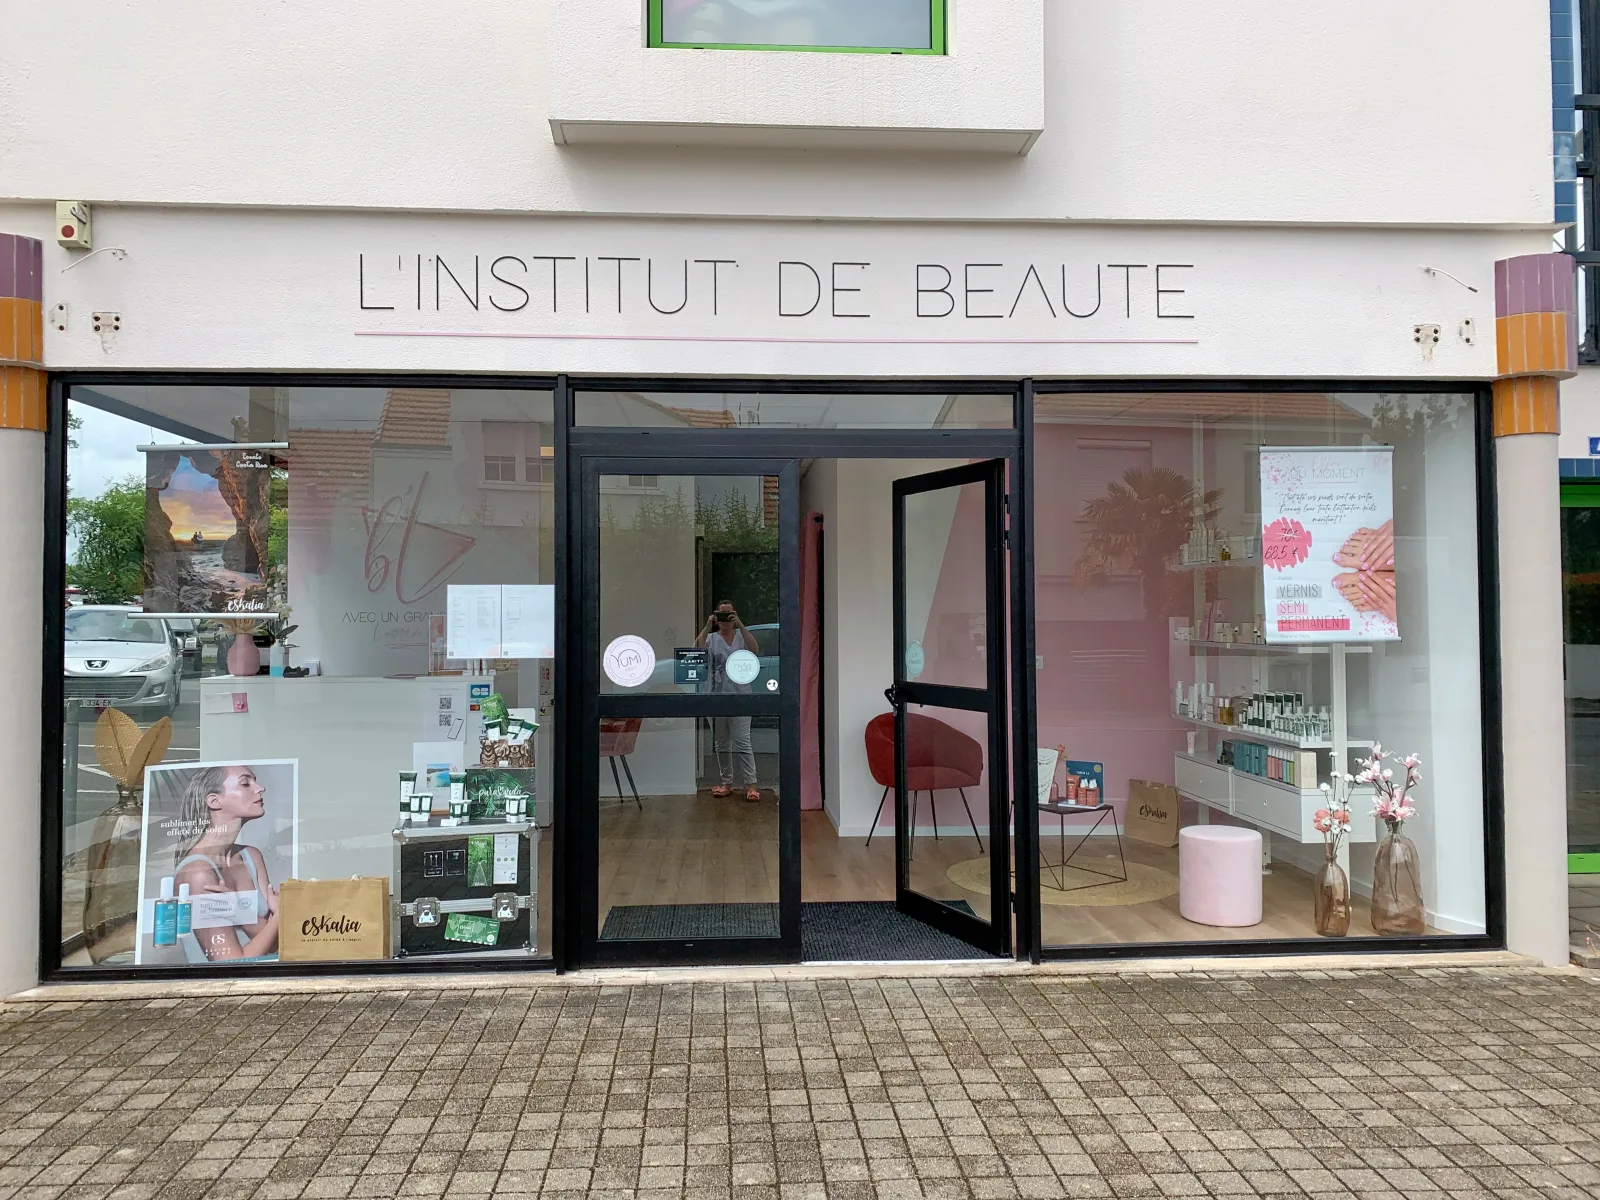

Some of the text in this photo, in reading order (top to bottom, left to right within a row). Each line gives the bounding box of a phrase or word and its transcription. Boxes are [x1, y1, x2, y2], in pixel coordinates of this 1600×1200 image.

[360, 253, 1195, 318] L'INSTITUT DE BEAUTE
[1290, 467, 1366, 479] DU MOMENT
[1318, 493, 1334, 502] pieds
[1336, 492, 1349, 502] sont
[1349, 492, 1357, 501] de
[1316, 504, 1331, 514] toute
[1291, 547, 1299, 558] €
[1279, 584, 1319, 597] VERNIS
[228, 598, 265, 611] eskalia
[1280, 600, 1306, 613] SEMI
[342, 611, 376, 622] AVEC
[381, 611, 399, 622] UN
[1280, 615, 1347, 629] PERMANENT
[610, 648, 642, 668] YUMI
[79, 699, 113, 708] A-334-EX
[160, 817, 211, 829] sublimer les
[166, 824, 228, 837] effets du soleil
[301, 914, 362, 937] eskalia
